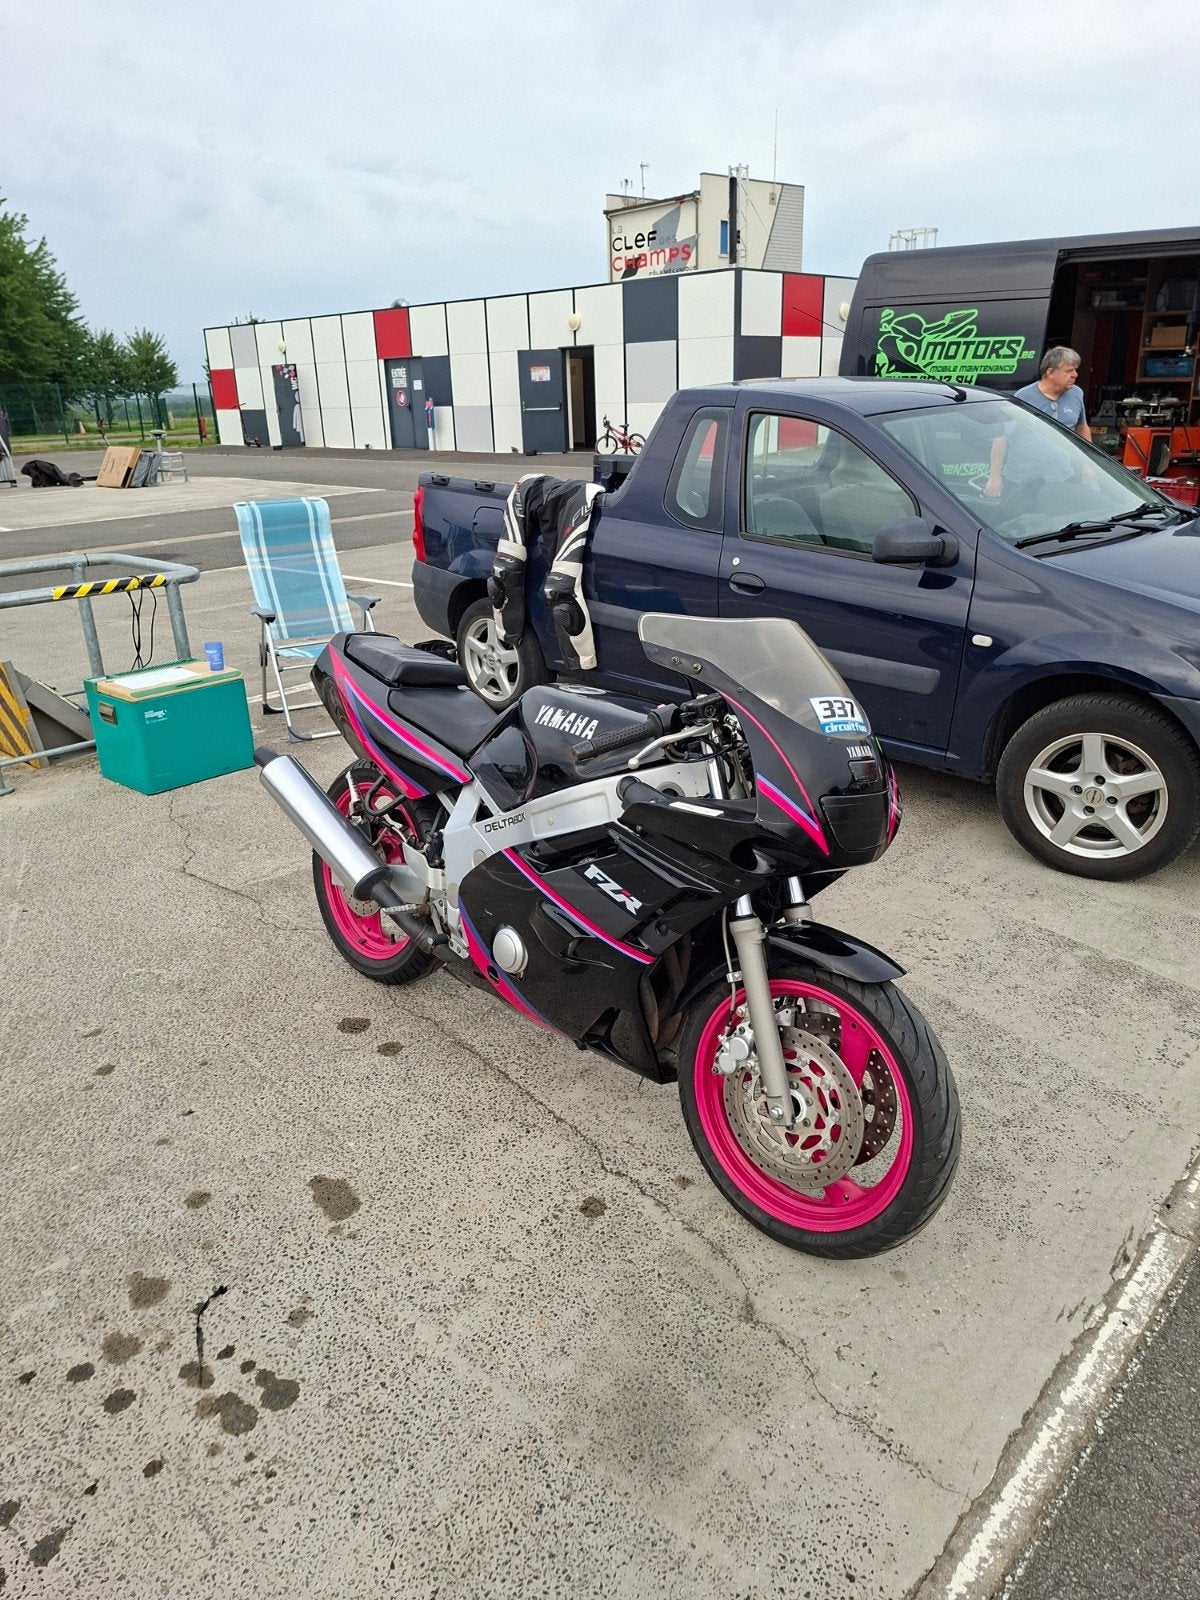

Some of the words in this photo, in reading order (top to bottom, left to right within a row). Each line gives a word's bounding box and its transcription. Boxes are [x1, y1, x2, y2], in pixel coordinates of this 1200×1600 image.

[921, 340, 1022, 360] MOTORS
[819, 700, 855, 719] 337
[534, 704, 599, 740] YAMAHA
[846, 745, 873, 759] YAMAHA
[484, 811, 526, 833] DELTABOX
[583, 864, 643, 916] FZR
